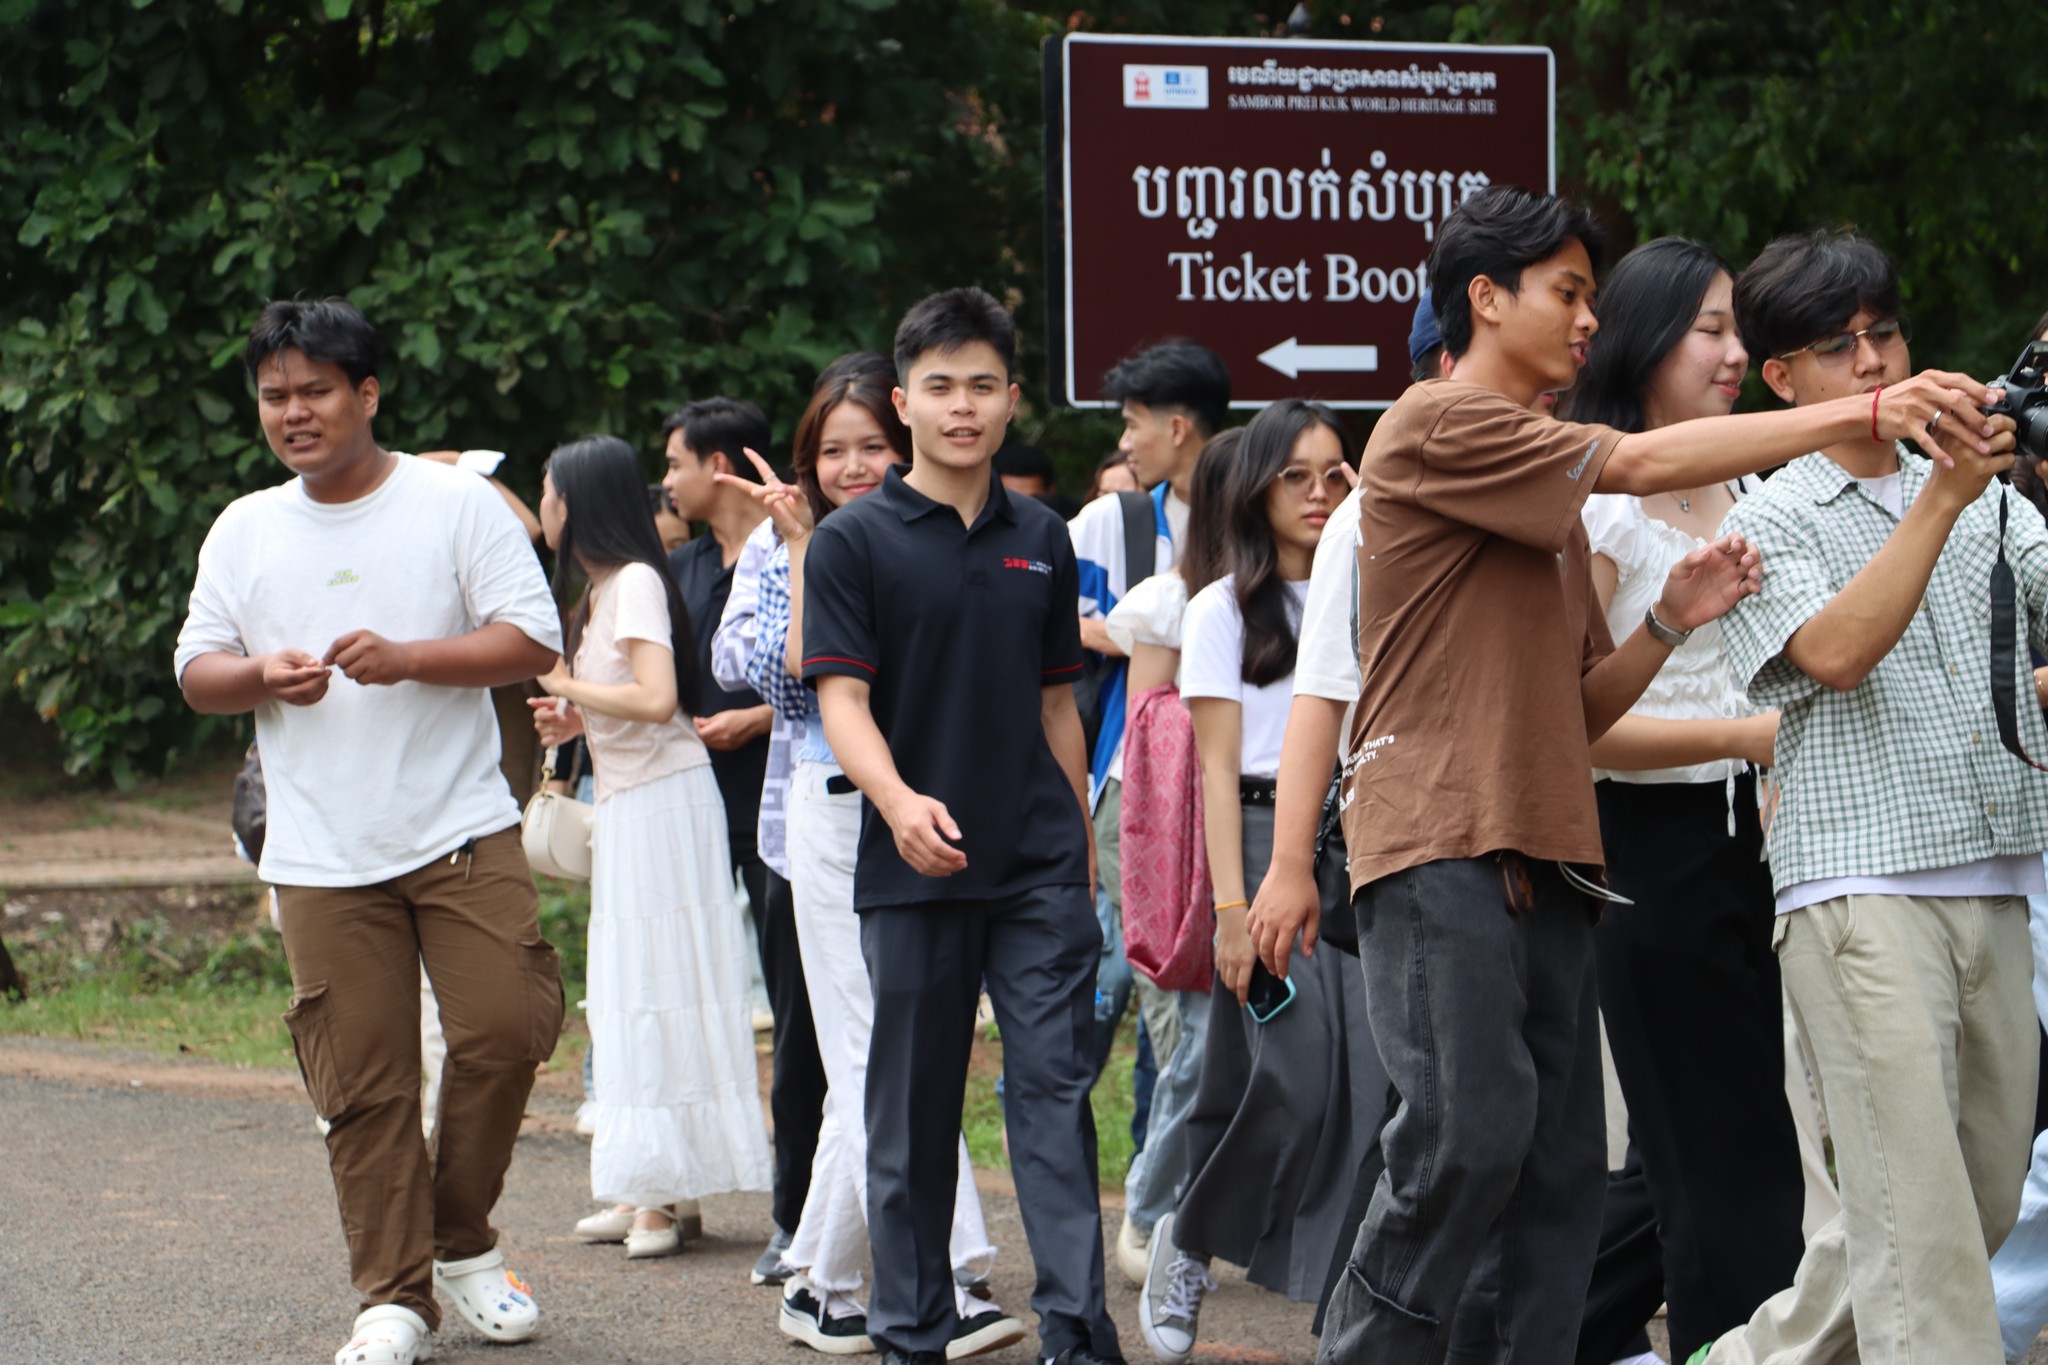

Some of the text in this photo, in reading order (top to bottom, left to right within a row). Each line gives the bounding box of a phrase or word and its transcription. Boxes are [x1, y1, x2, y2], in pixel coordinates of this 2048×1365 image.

[1227, 94, 1497, 114] SAMBOR PREI KUK WORLD HERITAGE SITE
[1168, 251, 1428, 303] Ticket Boot
[1363, 734, 1395, 750] THAT'S
